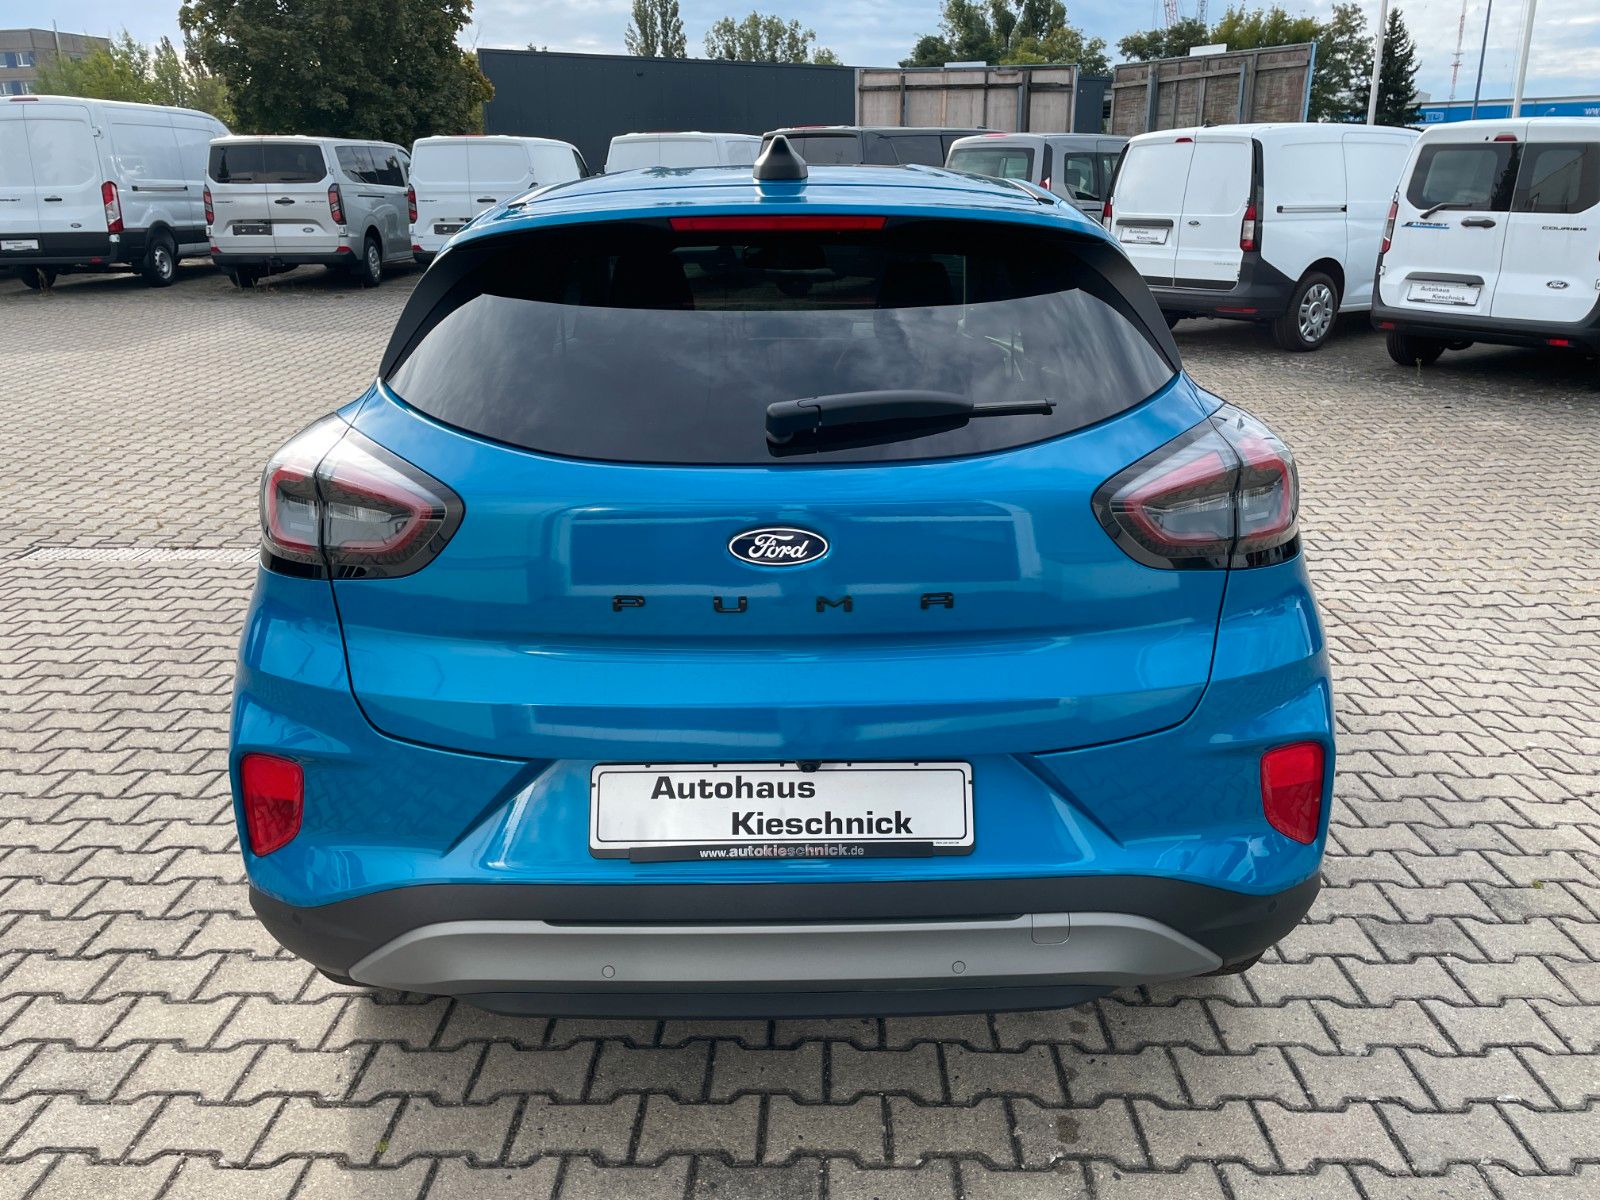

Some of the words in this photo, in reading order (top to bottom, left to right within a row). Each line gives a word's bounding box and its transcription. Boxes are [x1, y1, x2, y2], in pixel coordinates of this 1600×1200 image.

[749, 533, 807, 559] Ford
[612, 592, 955, 613] PUMA
[651, 776, 816, 799] Autohaus
[731, 811, 913, 835] Kieschnick
[699, 843, 864, 857] www.autokieschnick.de
